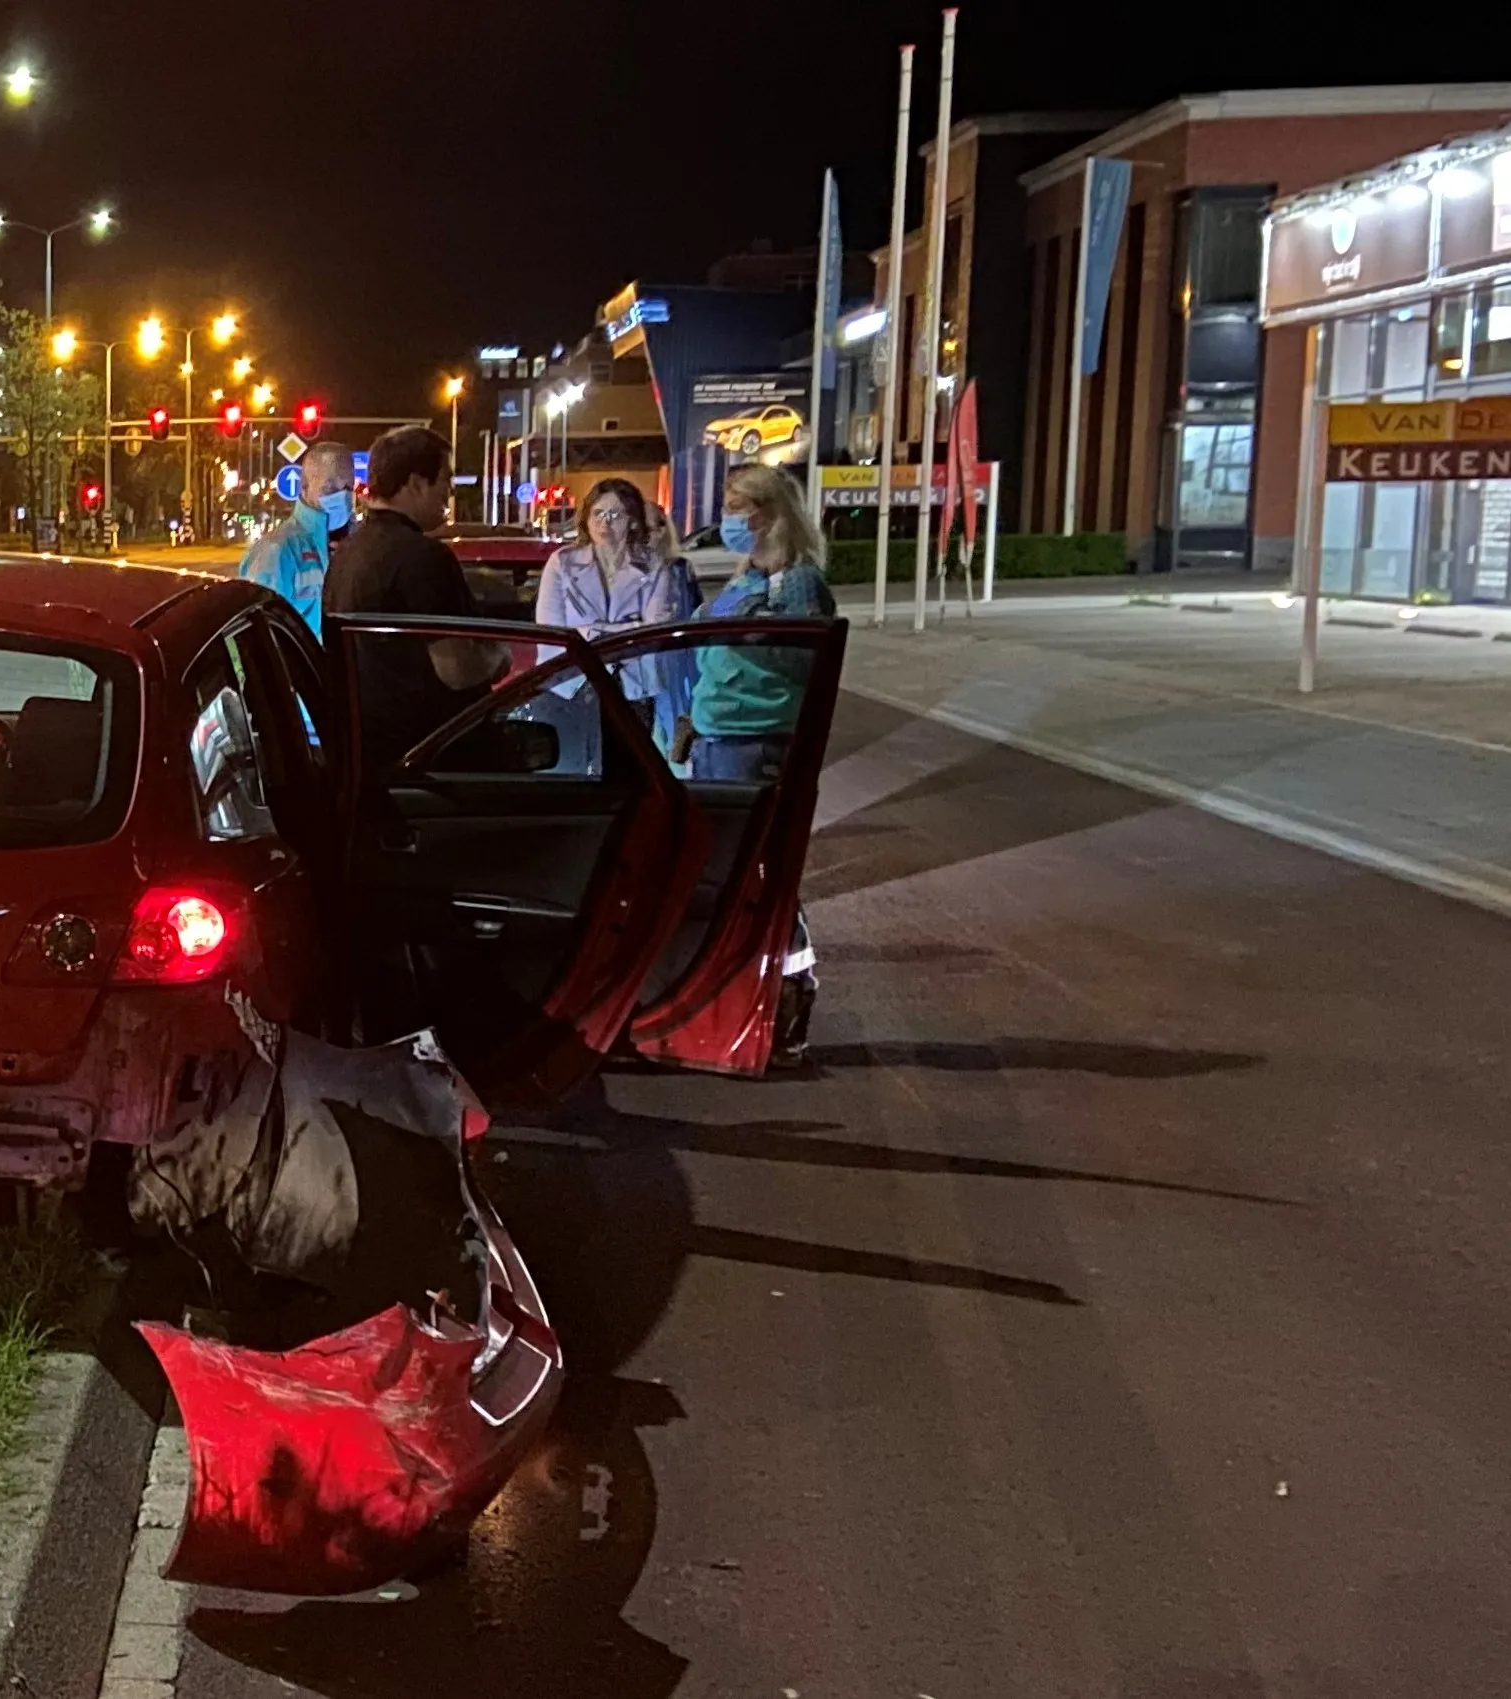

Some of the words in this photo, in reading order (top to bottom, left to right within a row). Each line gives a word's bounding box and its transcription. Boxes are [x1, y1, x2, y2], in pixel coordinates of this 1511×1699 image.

[1370, 410, 1441, 432] VAN
[1339, 448, 1510, 478] KEUKEN
[839, 471, 874, 483] VAN
[824, 488, 920, 505] KEUKNS
